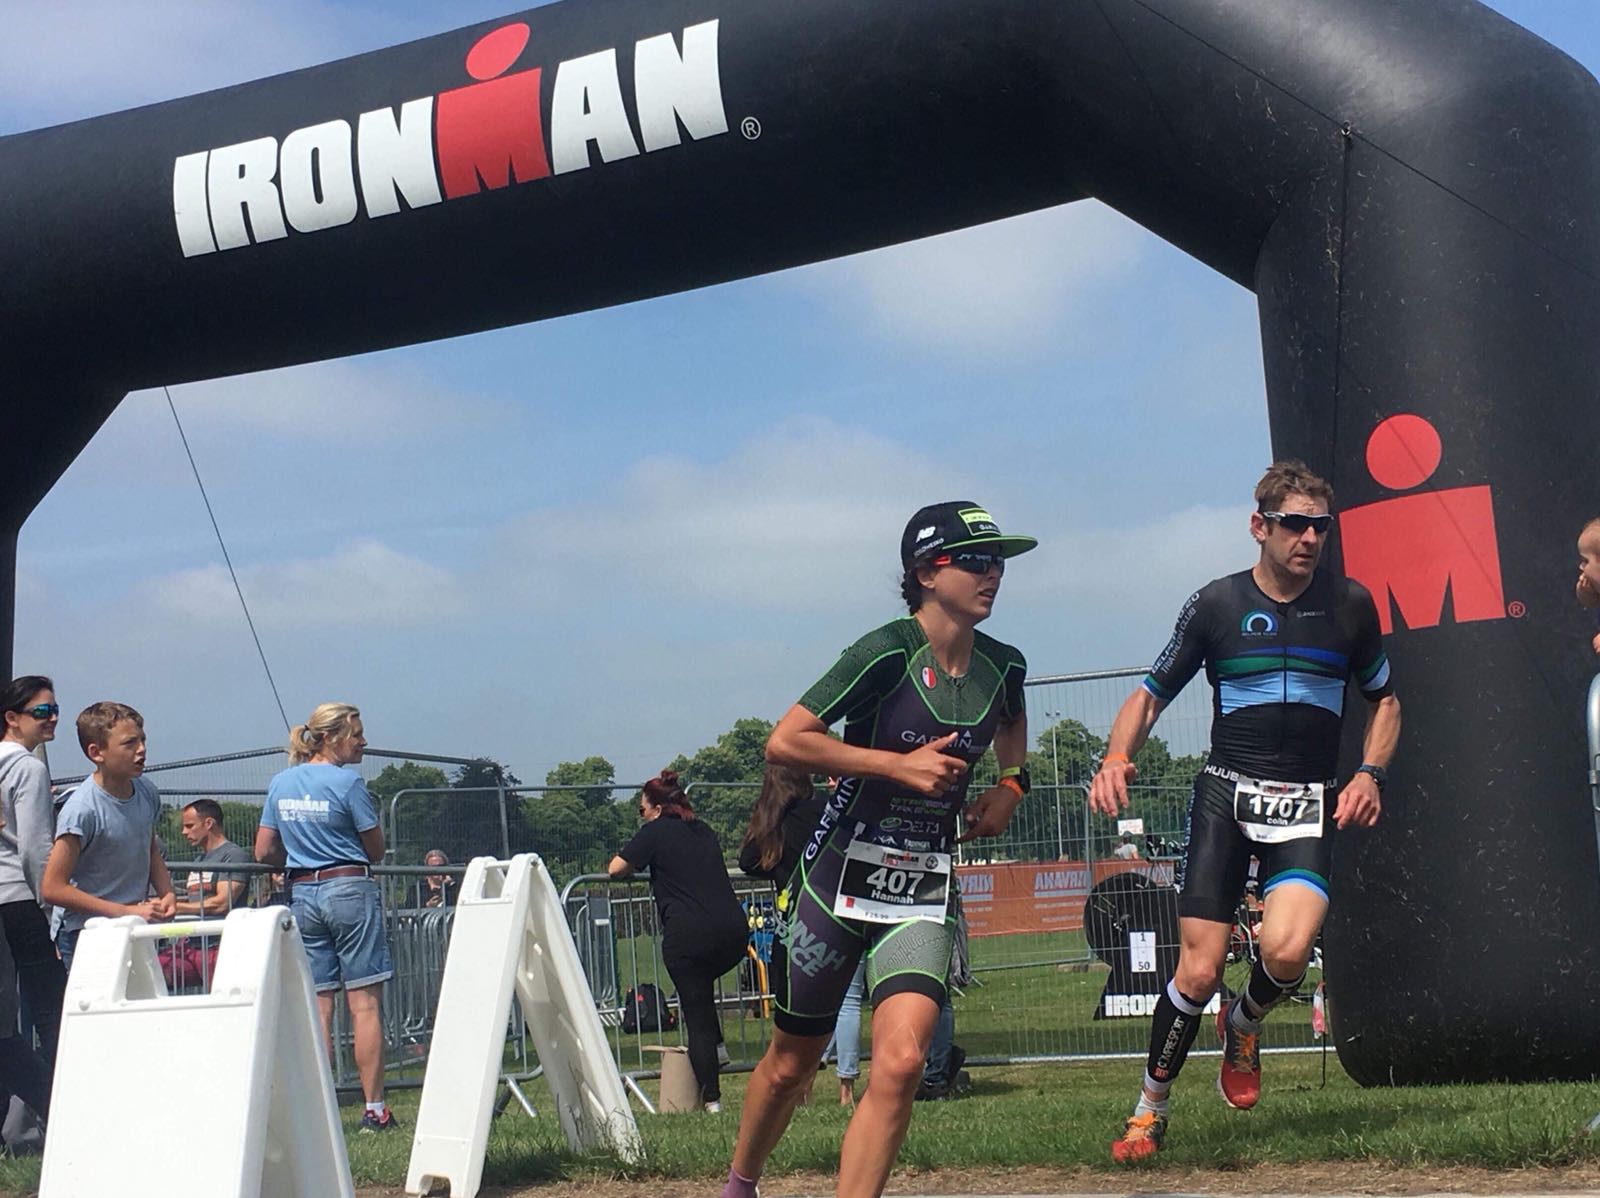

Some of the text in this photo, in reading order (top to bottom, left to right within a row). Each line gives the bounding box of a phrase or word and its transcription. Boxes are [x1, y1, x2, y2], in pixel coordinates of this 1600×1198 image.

[173, 19, 728, 258] IRONMAN
[900, 729, 973, 750] GAIN
[1203, 764, 1240, 782] HUUB
[1249, 794, 1309, 820] 1707
[865, 866, 925, 896] 407
[871, 889, 915, 905] Hannah
[1138, 961, 1151, 971] 50
